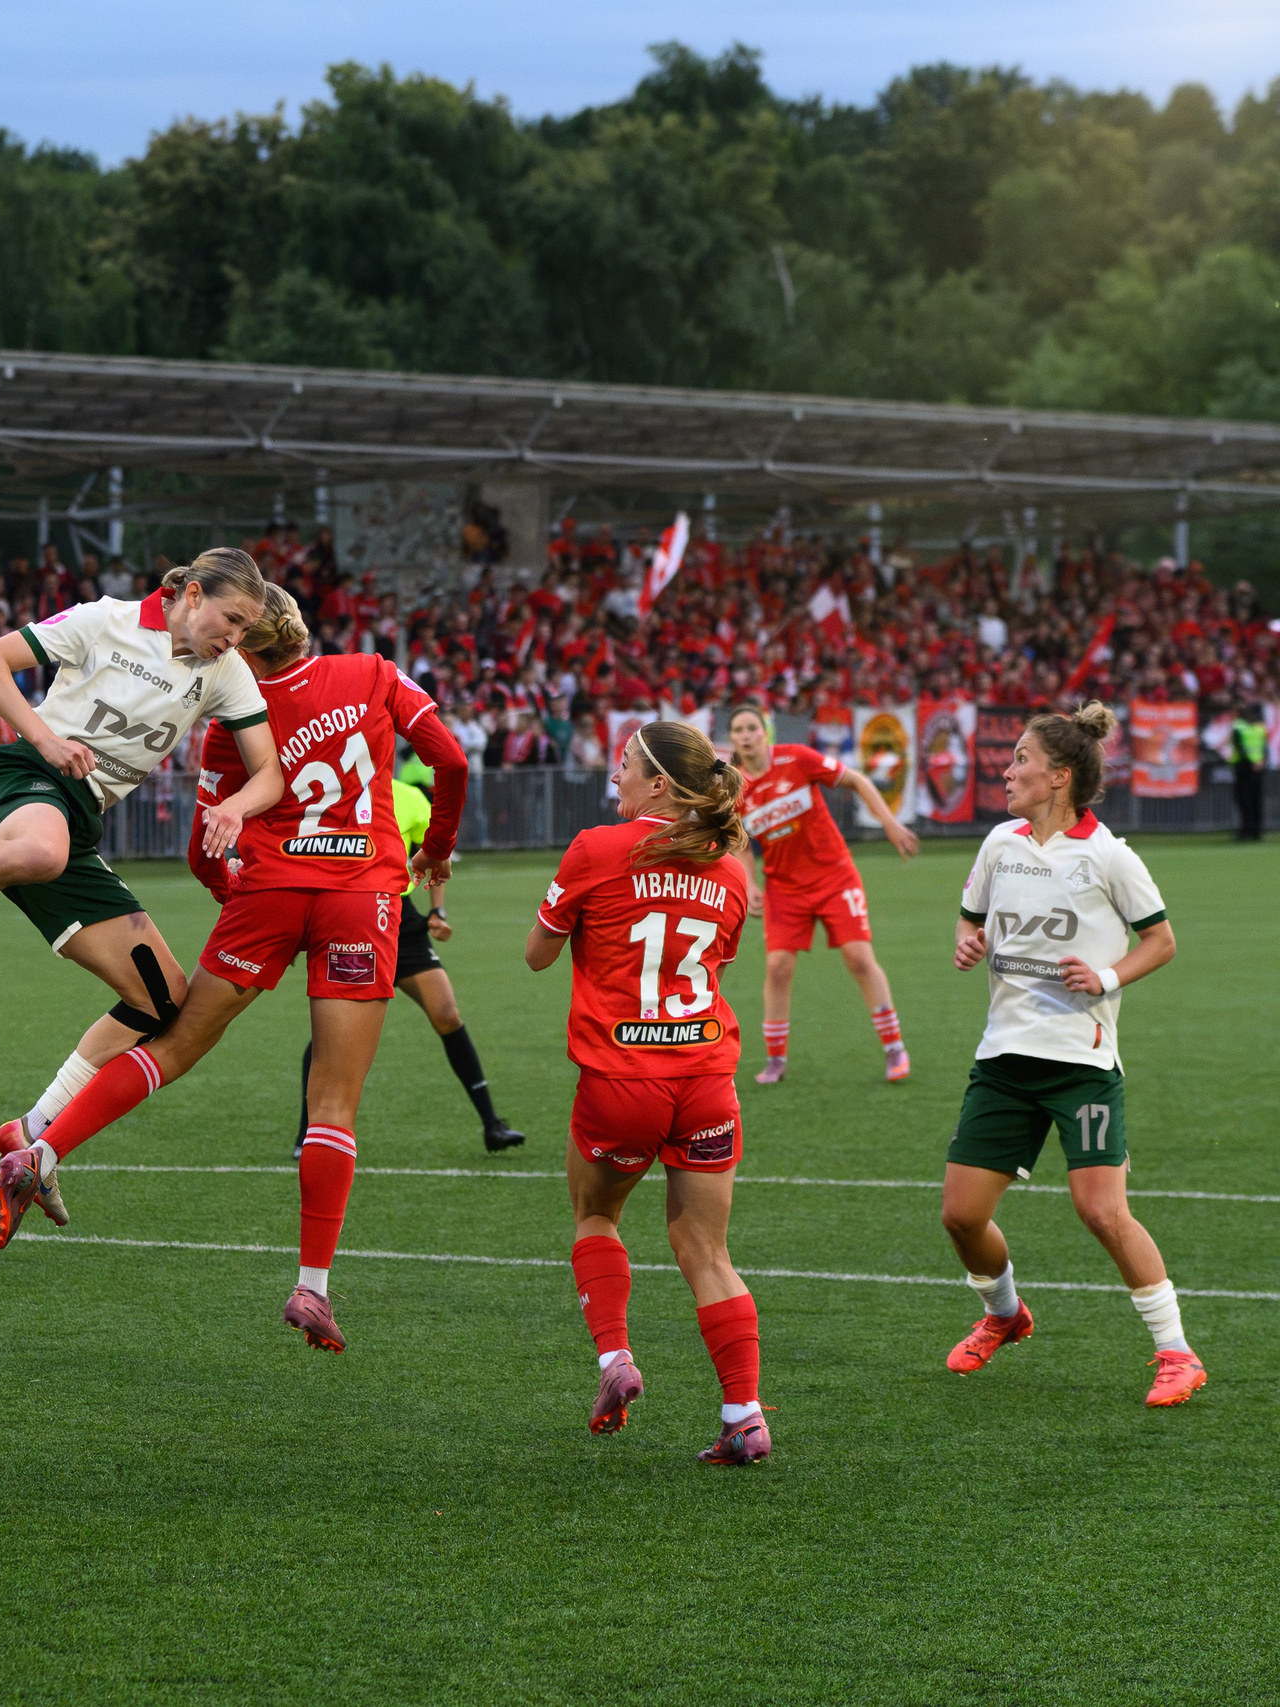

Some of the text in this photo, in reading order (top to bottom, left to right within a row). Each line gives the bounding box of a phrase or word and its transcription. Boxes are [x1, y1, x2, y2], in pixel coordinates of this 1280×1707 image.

[110, 651, 173, 694] BetBoom
[94, 753, 144, 782] КОМБАНК
[290, 731, 376, 837] 21
[288, 837, 368, 855] WINLINE
[996, 861, 1053, 878] BetBoom
[631, 872, 727, 912] ИВАНУША
[842, 888, 868, 917] 12
[328, 942, 373, 953] ЛУКОЙЛ
[217, 950, 265, 975] GENES
[629, 911, 718, 1020] 13
[1000, 959, 1063, 977] СОВКОМБАН
[622, 1023, 701, 1043] WINLINE
[691, 1118, 735, 1141] ЛУКОЙЛ
[1075, 1103, 1110, 1152] 17
